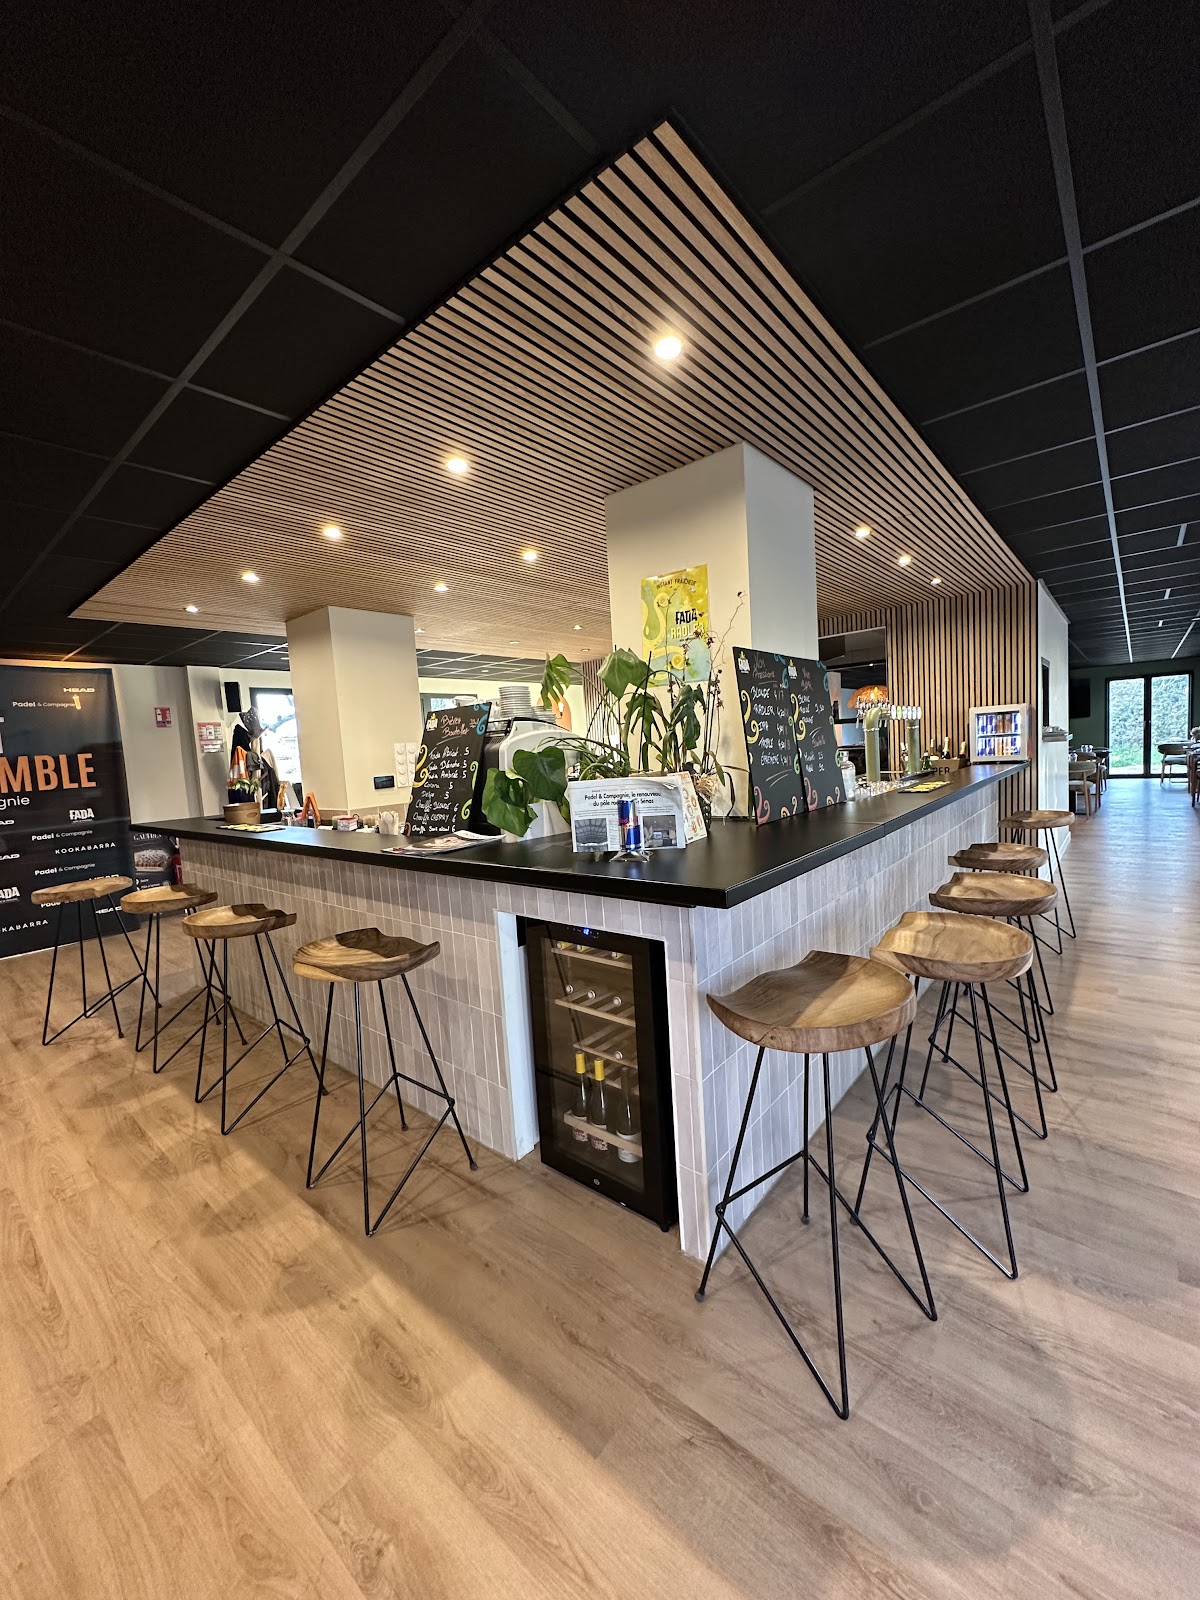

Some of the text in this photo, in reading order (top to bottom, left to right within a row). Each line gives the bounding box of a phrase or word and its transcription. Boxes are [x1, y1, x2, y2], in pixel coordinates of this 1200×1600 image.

[675, 608, 698, 625] FADA
[671, 622, 705, 639] RADLER
[69, 807, 95, 820] FADA
[31, 833, 54, 841] Padel
[55, 842, 116, 855] KOOKABARRA
[34, 868, 57, 876] Padel
[63, 863, 96, 871] Compagnie
